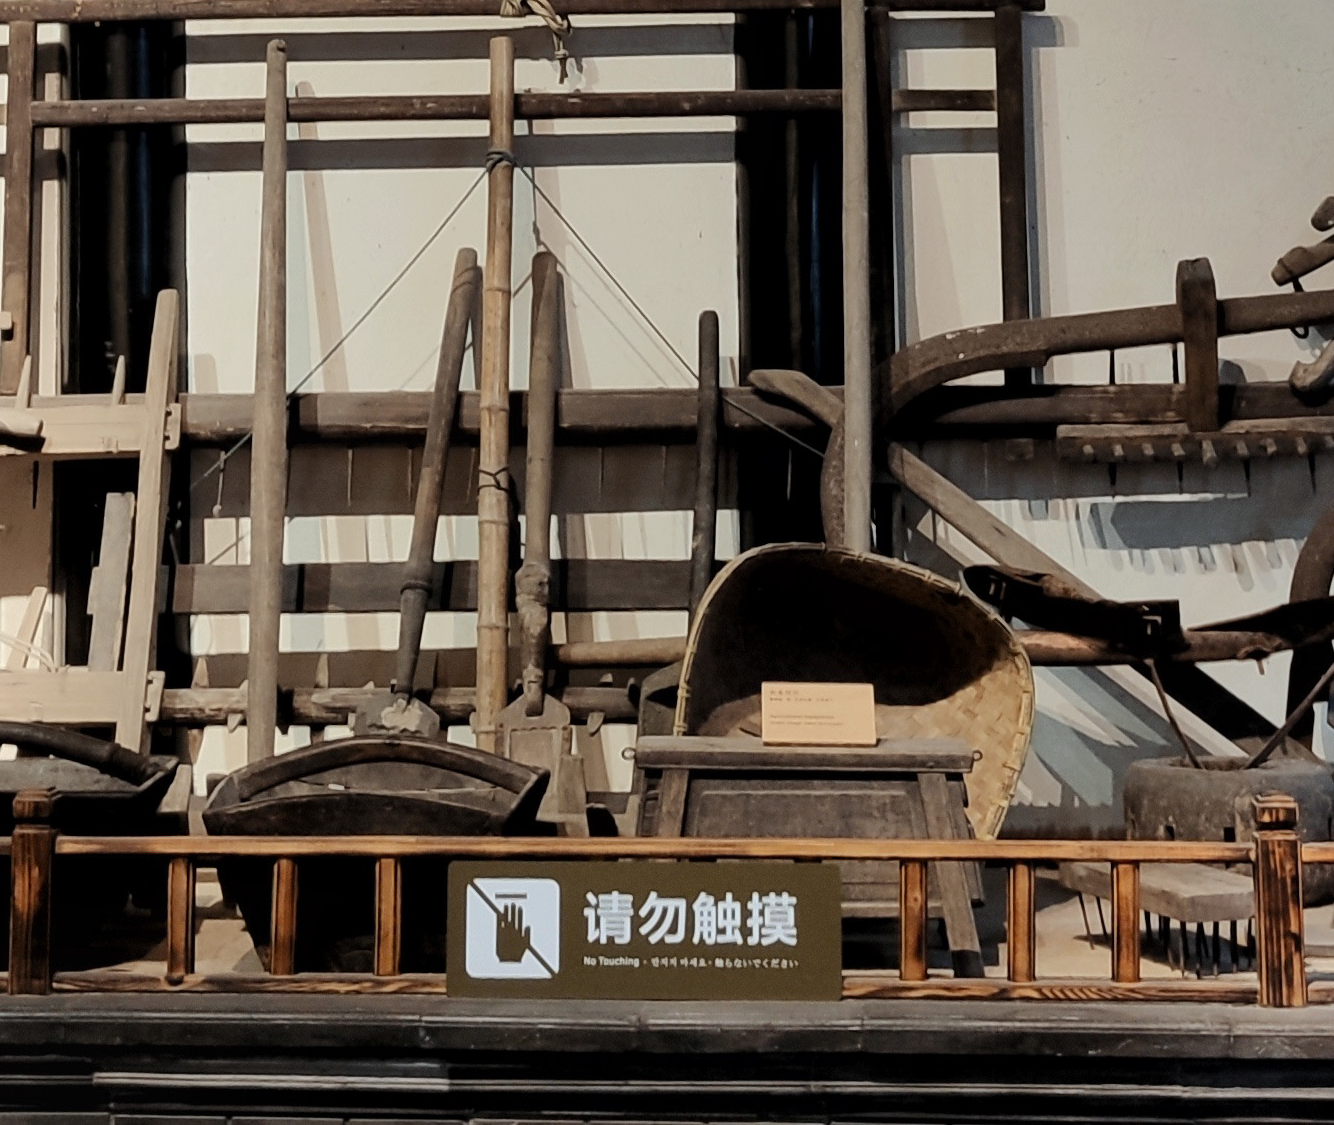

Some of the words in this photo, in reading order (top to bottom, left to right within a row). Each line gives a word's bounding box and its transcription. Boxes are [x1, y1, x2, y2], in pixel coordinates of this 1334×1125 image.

[583, 889, 799, 947] 请勿触摸
[583, 955, 597, 966] No
[598, 955, 641, 968] Touching
